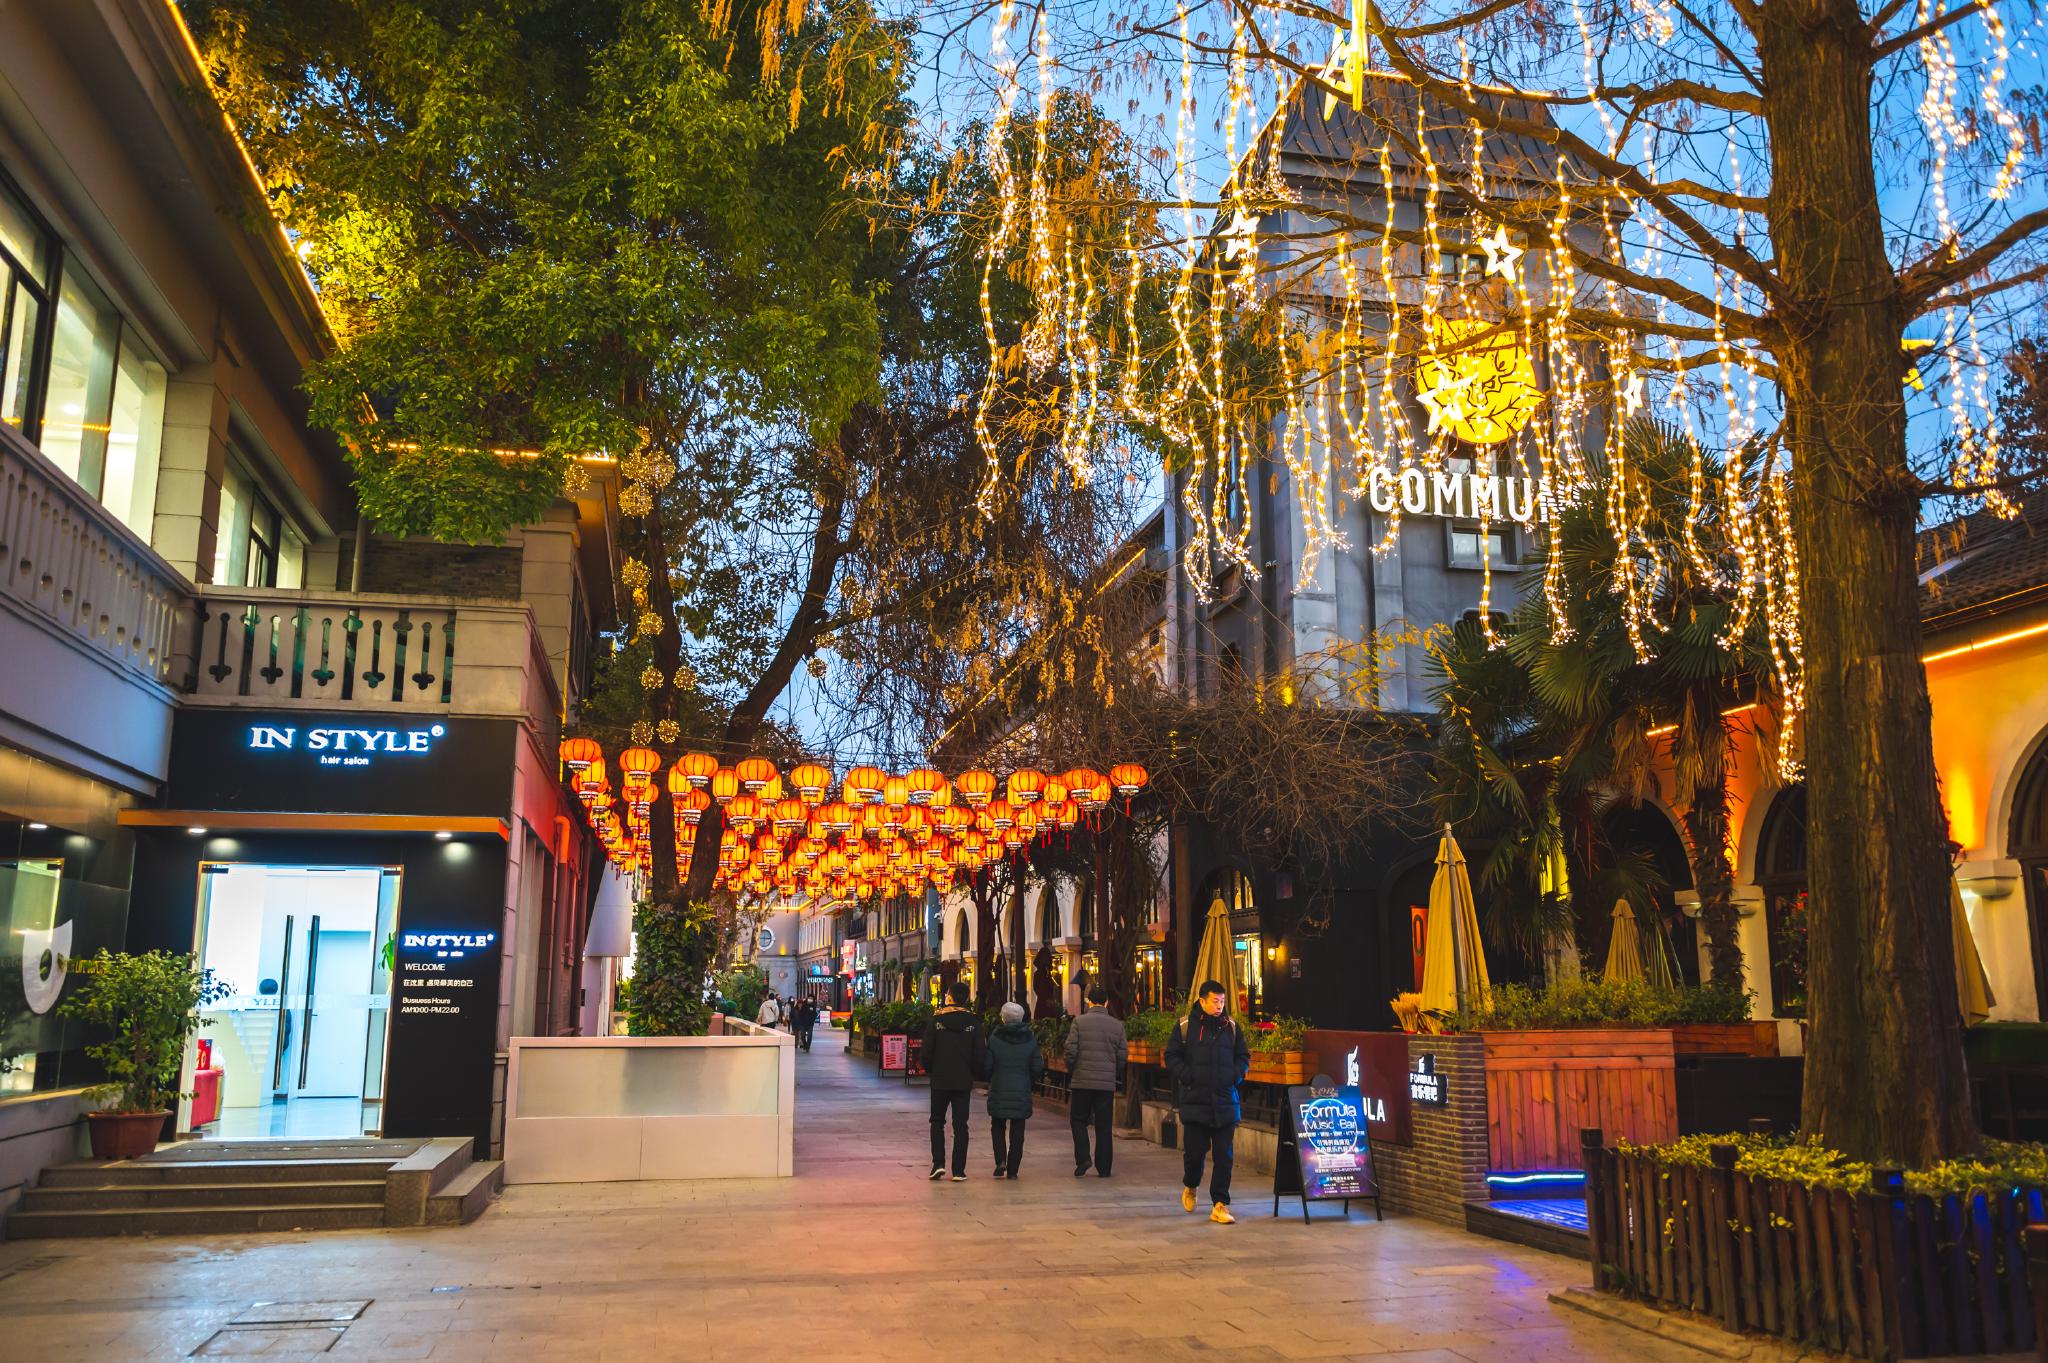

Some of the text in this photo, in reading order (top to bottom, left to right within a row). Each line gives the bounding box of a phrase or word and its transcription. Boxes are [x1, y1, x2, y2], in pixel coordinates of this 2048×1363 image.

[249, 726, 430, 752] IN STYLE
[320, 754, 369, 766] hair salon
[404, 963, 447, 971] WELCOME
[1299, 1103, 1358, 1119] Formula
[1302, 1118, 1357, 1130] Music Bar
